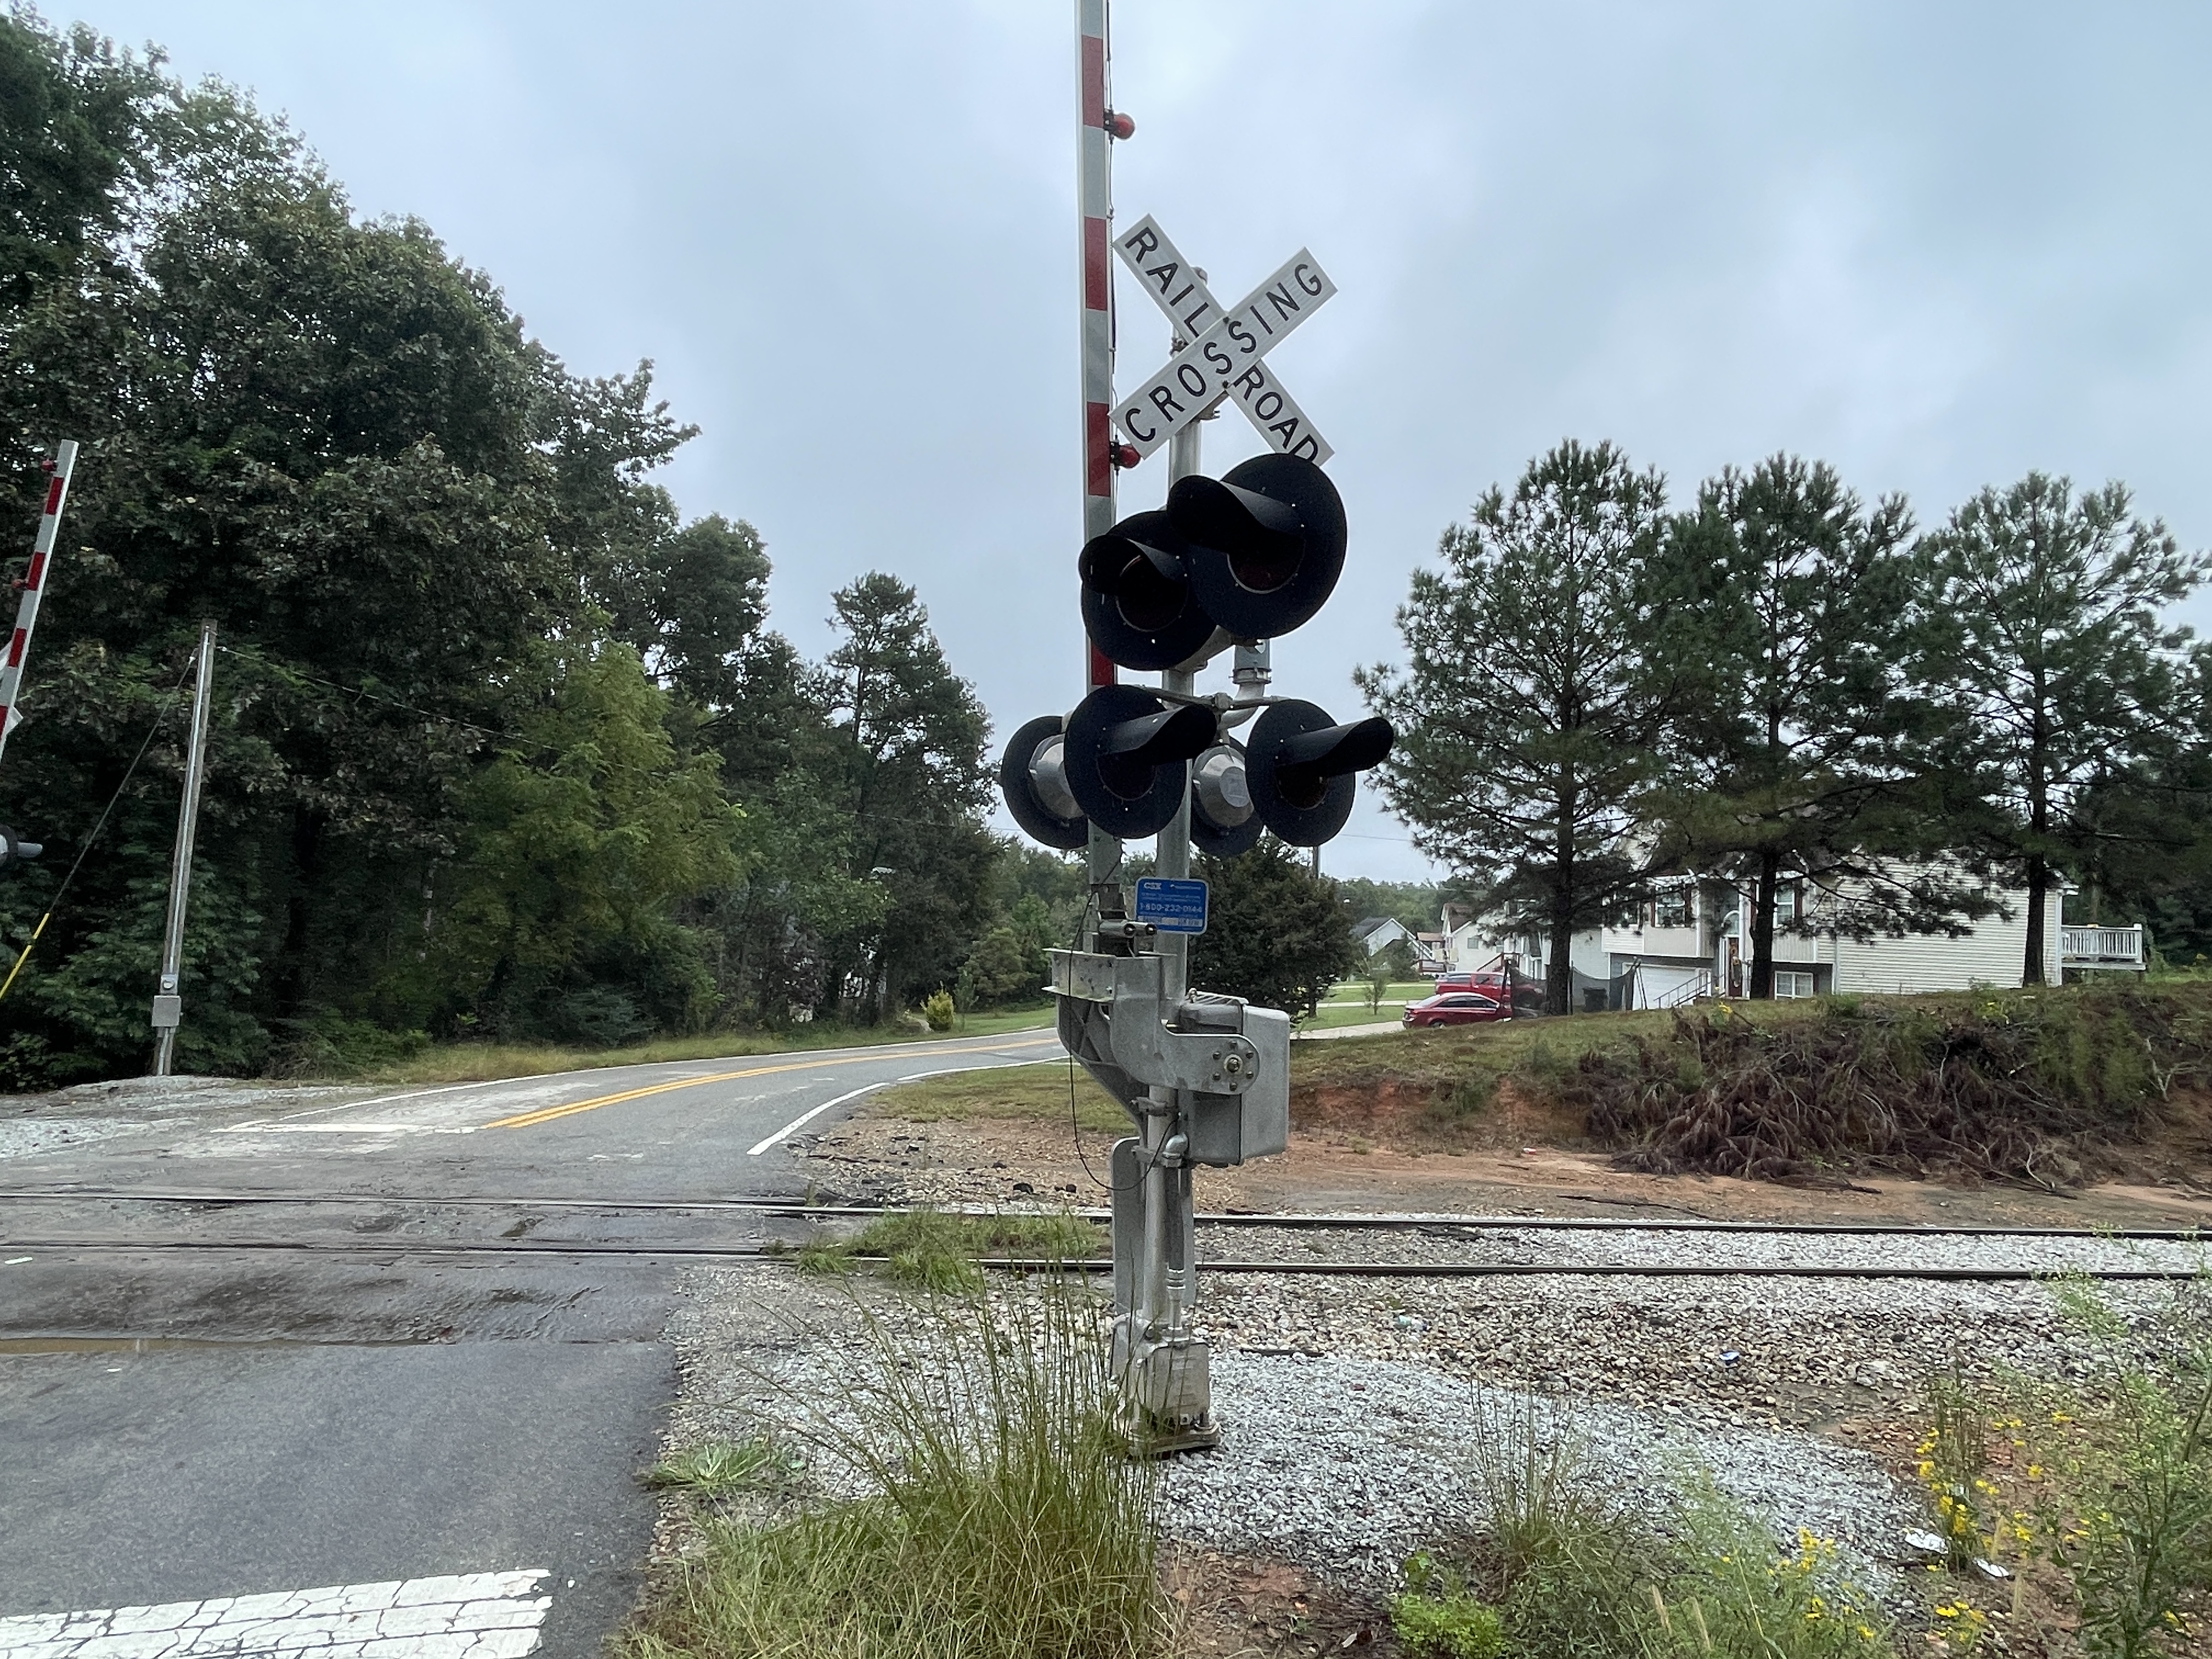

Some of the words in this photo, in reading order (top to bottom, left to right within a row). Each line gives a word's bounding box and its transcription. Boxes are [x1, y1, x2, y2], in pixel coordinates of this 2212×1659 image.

[1125, 227, 1209, 337] RAIL
[1234, 365, 1319, 462] ROAD
[1125, 263, 1322, 442] CROSSING
